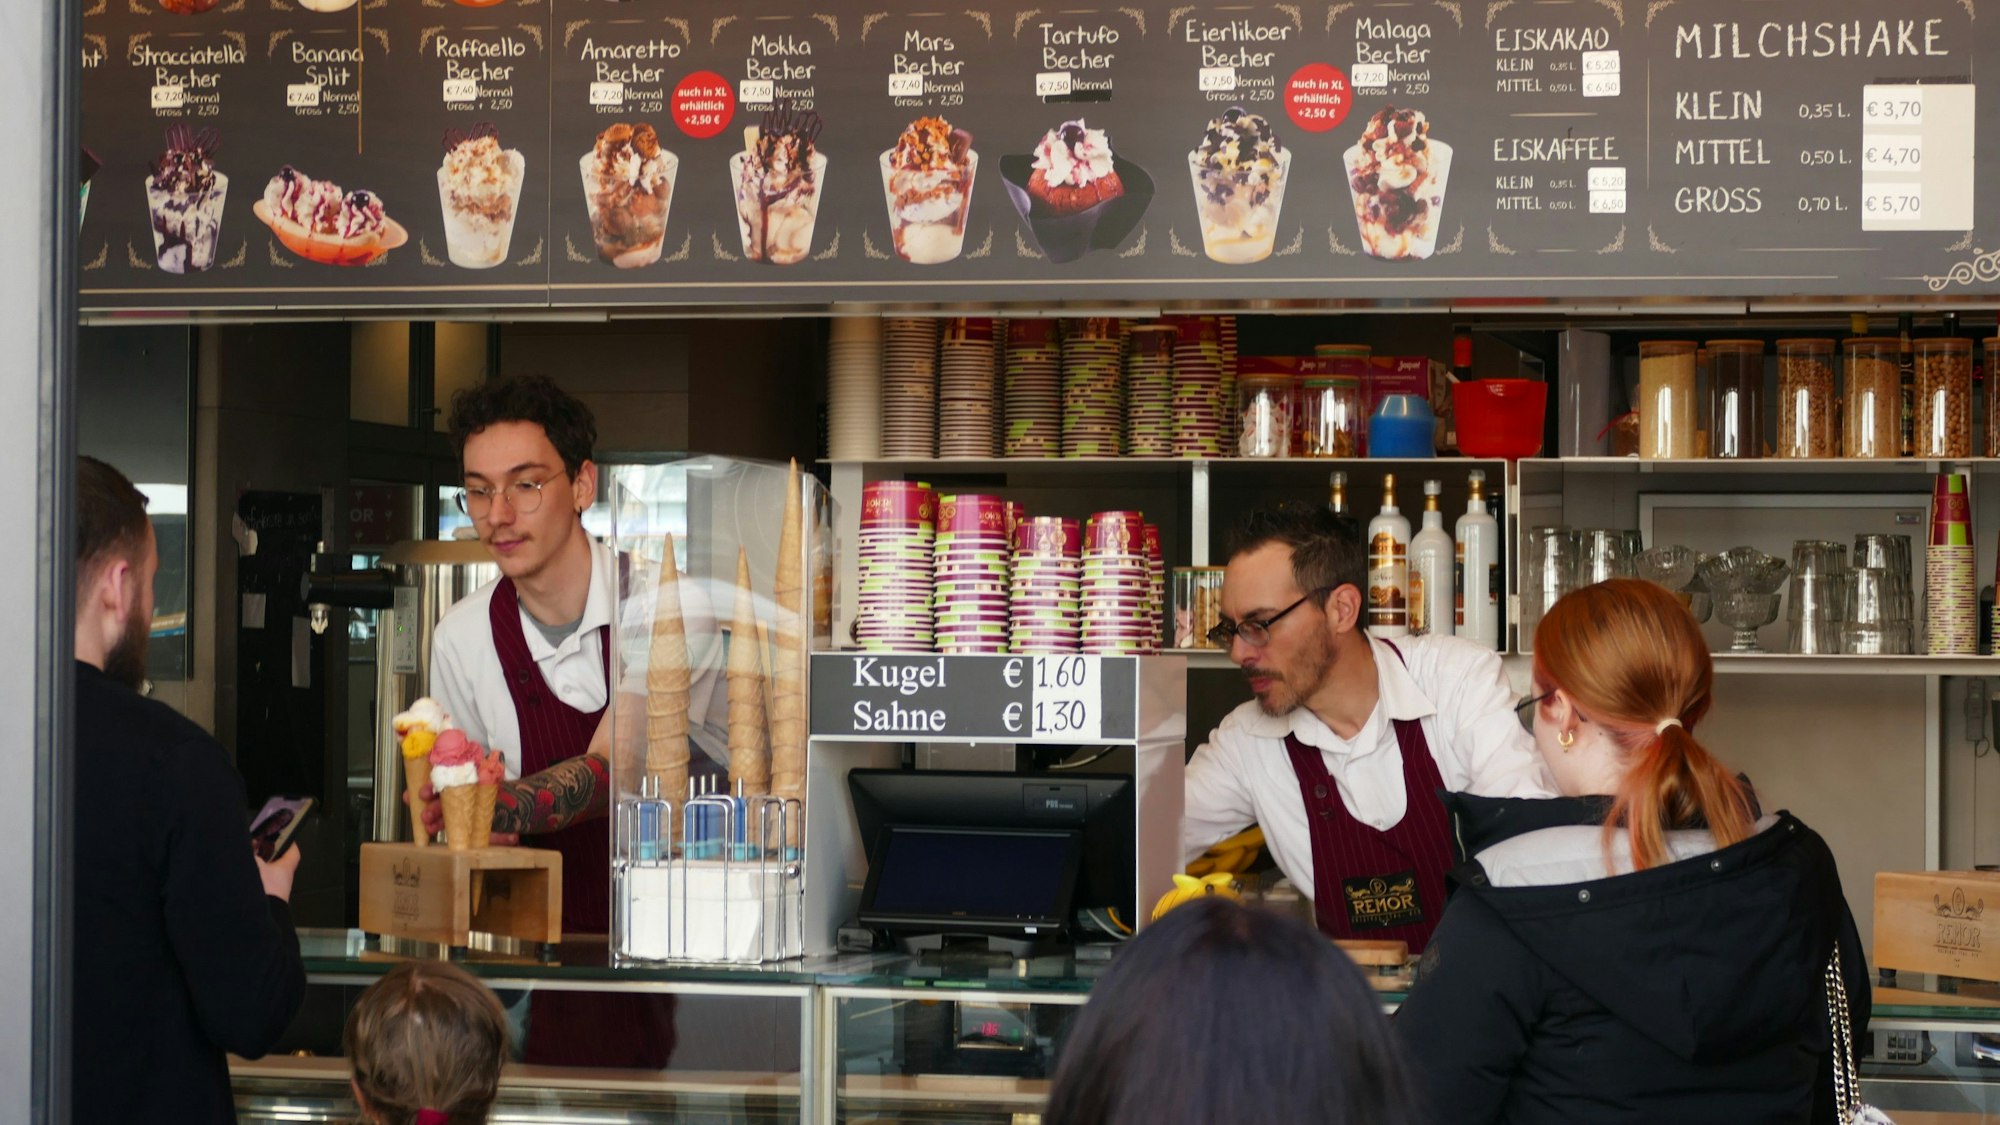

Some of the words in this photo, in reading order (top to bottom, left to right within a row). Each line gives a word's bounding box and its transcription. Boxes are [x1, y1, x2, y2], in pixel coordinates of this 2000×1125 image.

[904, 29, 955, 52] Mars
[1039, 22, 1119, 46] Tartufo
[1185, 18, 1291, 43] Eierlikoer
[1355, 16, 1431, 46] Malaga
[1496, 26, 1609, 52] EISKAKAO
[1675, 18, 1949, 59] MILCHSHAKE
[292, 41, 364, 64] Banana
[436, 35, 526, 58] Raffaello
[580, 37, 681, 61] Amaretto
[750, 33, 812, 56] Mokka
[1356, 41, 1431, 64] Becher
[81, 48, 103, 68] ht
[132, 44, 245, 66] Stracciatella
[893, 53, 965, 76] Becher
[1043, 46, 1115, 69] Becher
[1201, 44, 1275, 68] Becher
[1496, 58, 1534, 72] KLEIN
[1586, 60, 1593, 70] €
[1595, 60, 1617, 71] 5,20
[156, 67, 221, 88] Becher
[305, 65, 351, 92] Split
[446, 59, 514, 81] Becher
[595, 61, 665, 83] Becher
[746, 57, 816, 80] Becher
[1354, 73, 1361, 82] €
[1364, 72, 1384, 82] 7,20
[1388, 68, 1430, 82] Normal
[892, 80, 898, 90] €
[901, 80, 920, 91] 7,40
[924, 80, 964, 93] Normal
[1039, 82, 1046, 91] €
[1048, 81, 1069, 92] 7,50
[1072, 77, 1113, 91] Normal
[1203, 76, 1209, 85] €
[1212, 76, 1232, 86] 7,50
[1234, 74, 1275, 87] Normal
[1292, 79, 1316, 89] auch
[1318, 79, 1329, 89] in
[1331, 80, 1344, 90] XL
[1405, 83, 1430, 95] 2,50
[1496, 78, 1542, 93] MITTEL
[1587, 83, 1593, 92] €
[1596, 82, 1617, 93] 6,50
[154, 93, 161, 101] €
[165, 92, 183, 101] 7,20
[183, 92, 220, 104] Normal
[289, 93, 295, 102] €
[297, 92, 315, 103] 7,40
[323, 90, 360, 103] Normal
[446, 87, 453, 96] €
[455, 86, 473, 97] 7,40
[476, 85, 513, 98] Normal
[592, 90, 598, 100] €
[603, 90, 622, 101] 7,20
[624, 87, 663, 100] Normal
[677, 86, 701, 97] auch
[703, 86, 712, 97] in
[714, 87, 727, 97] XL
[743, 87, 749, 96] €
[752, 86, 771, 97] 7,50
[775, 85, 815, 98] Normal
[940, 94, 964, 106] 2,50
[1250, 89, 1275, 101] 2,50
[1293, 92, 1341, 105] erhältlich
[198, 106, 219, 117] 2,50
[338, 103, 360, 115] 2,50
[490, 99, 513, 110] 2,50
[640, 101, 663, 113] 2,50
[679, 100, 725, 112] erhältlich
[791, 99, 814, 111] 2,50
[1298, 107, 1327, 119] +2,50
[1329, 108, 1335, 118] €
[1675, 90, 1763, 121] KLEIN
[1798, 103, 1833, 119] 0,35
[1837, 102, 1851, 118] L.
[1866, 101, 1878, 117] €
[1883, 100, 1922, 121] 3,70
[684, 115, 712, 126] +2,50
[714, 115, 720, 125] €
[1494, 136, 1619, 161] EISKAFFEE
[1675, 138, 1771, 165] MITTEL
[1800, 150, 1834, 166] 0,50
[1839, 149, 1852, 165] L.
[1865, 148, 1877, 164] €
[1882, 147, 1921, 168] 4,70
[1496, 175, 1534, 190] KLEIN
[1602, 176, 1623, 187] 5,20
[1496, 196, 1542, 210] MITTEL
[1602, 199, 1623, 211] 6,50
[1674, 186, 1763, 214] GROSS
[1798, 197, 1831, 212] 0,70
[1835, 195, 1848, 211] L.
[1864, 196, 1877, 212] €
[1882, 195, 1921, 216] 5,70
[852, 657, 947, 695] Kugel
[1002, 657, 1024, 688] €
[852, 700, 947, 732] Sahne
[1002, 701, 1024, 732] €
[1352, 894, 1415, 915] REMOR
